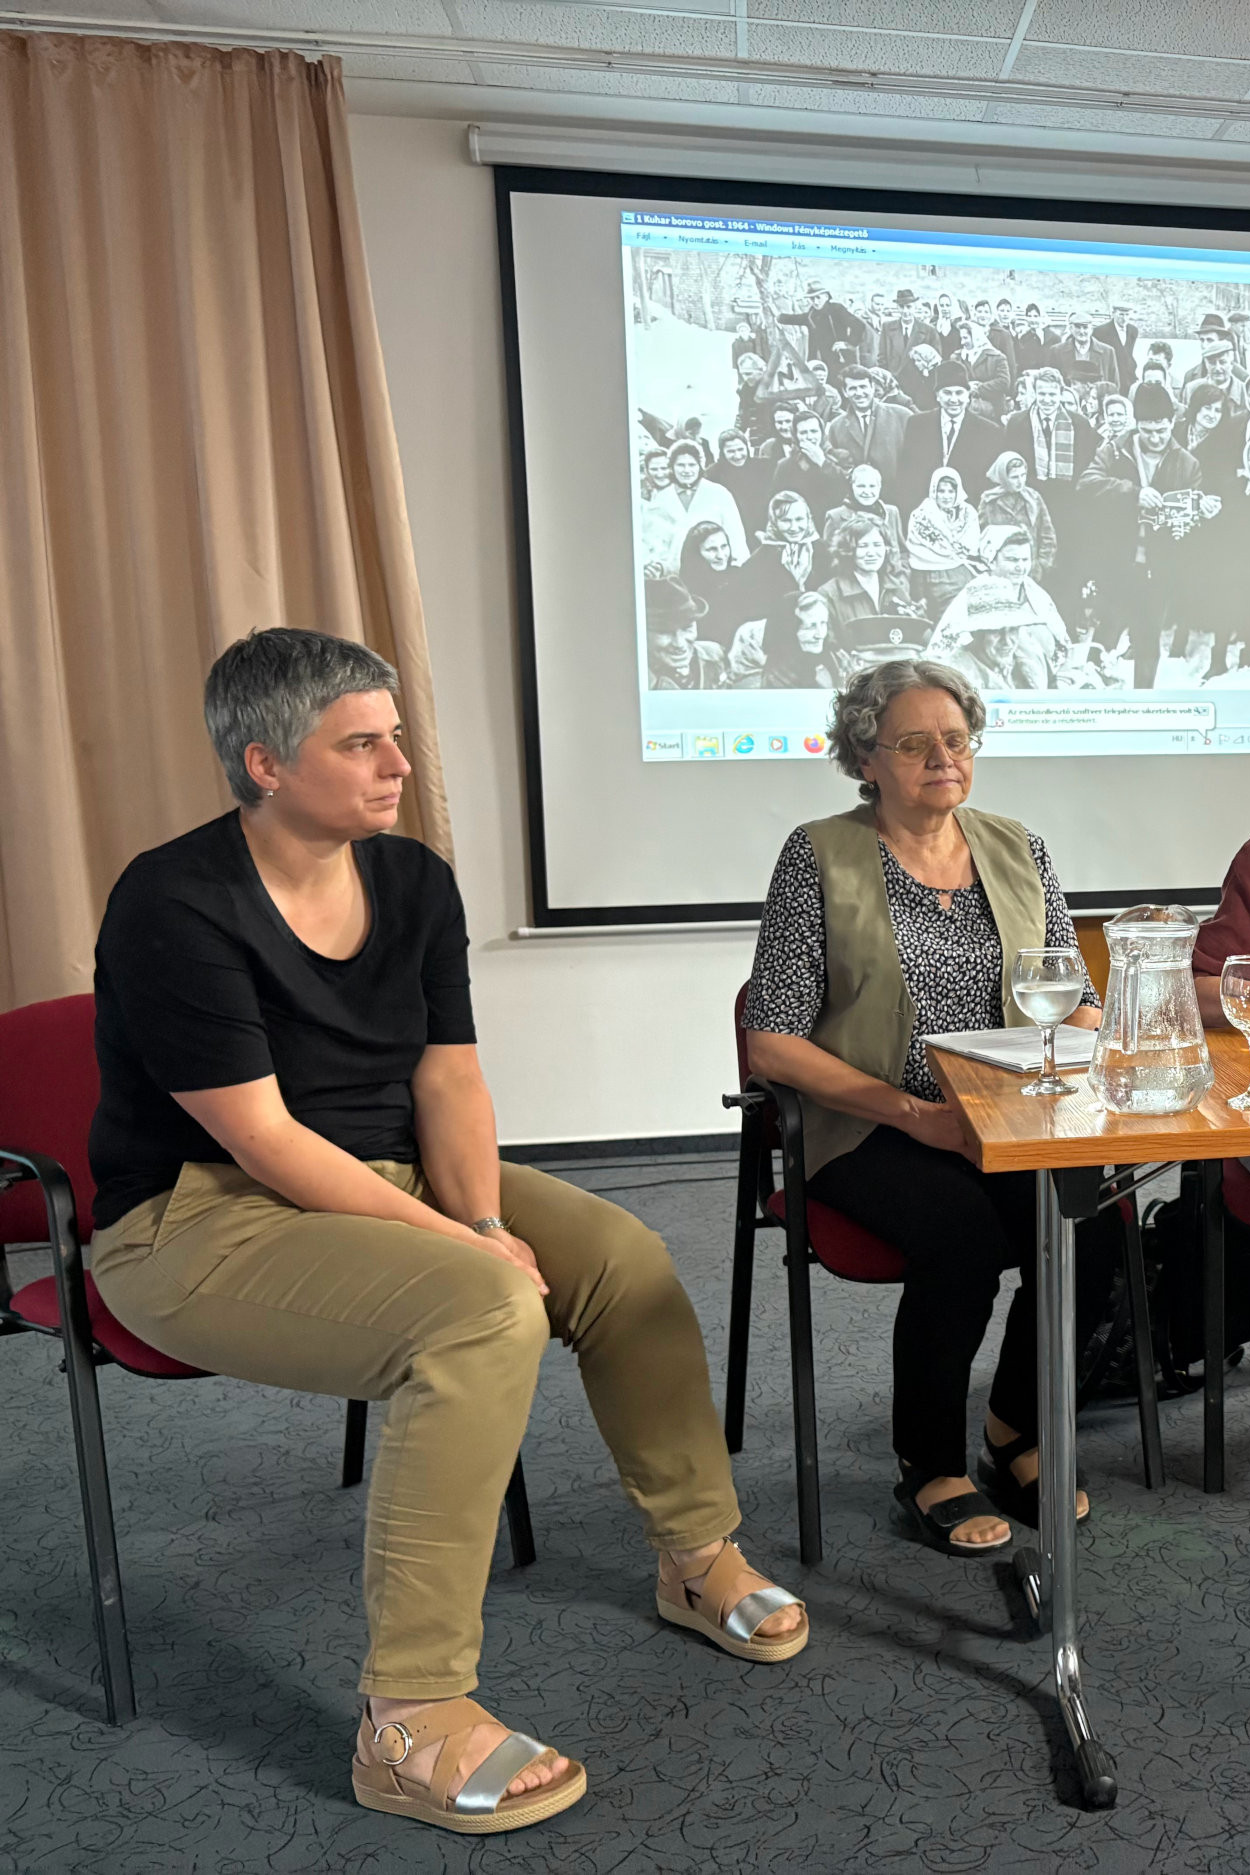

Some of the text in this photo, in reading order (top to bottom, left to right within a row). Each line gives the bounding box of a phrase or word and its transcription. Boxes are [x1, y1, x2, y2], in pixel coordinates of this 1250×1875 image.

[637, 215, 642, 223] 1
[644, 215, 670, 225] Kuhar
[671, 216, 703, 227] borovo
[704, 219, 726, 229] gost.
[727, 221, 749, 230] 1964
[756, 223, 794, 233] Windows
[744, 239, 768, 248] E-mail
[658, 742, 680, 750] Start
